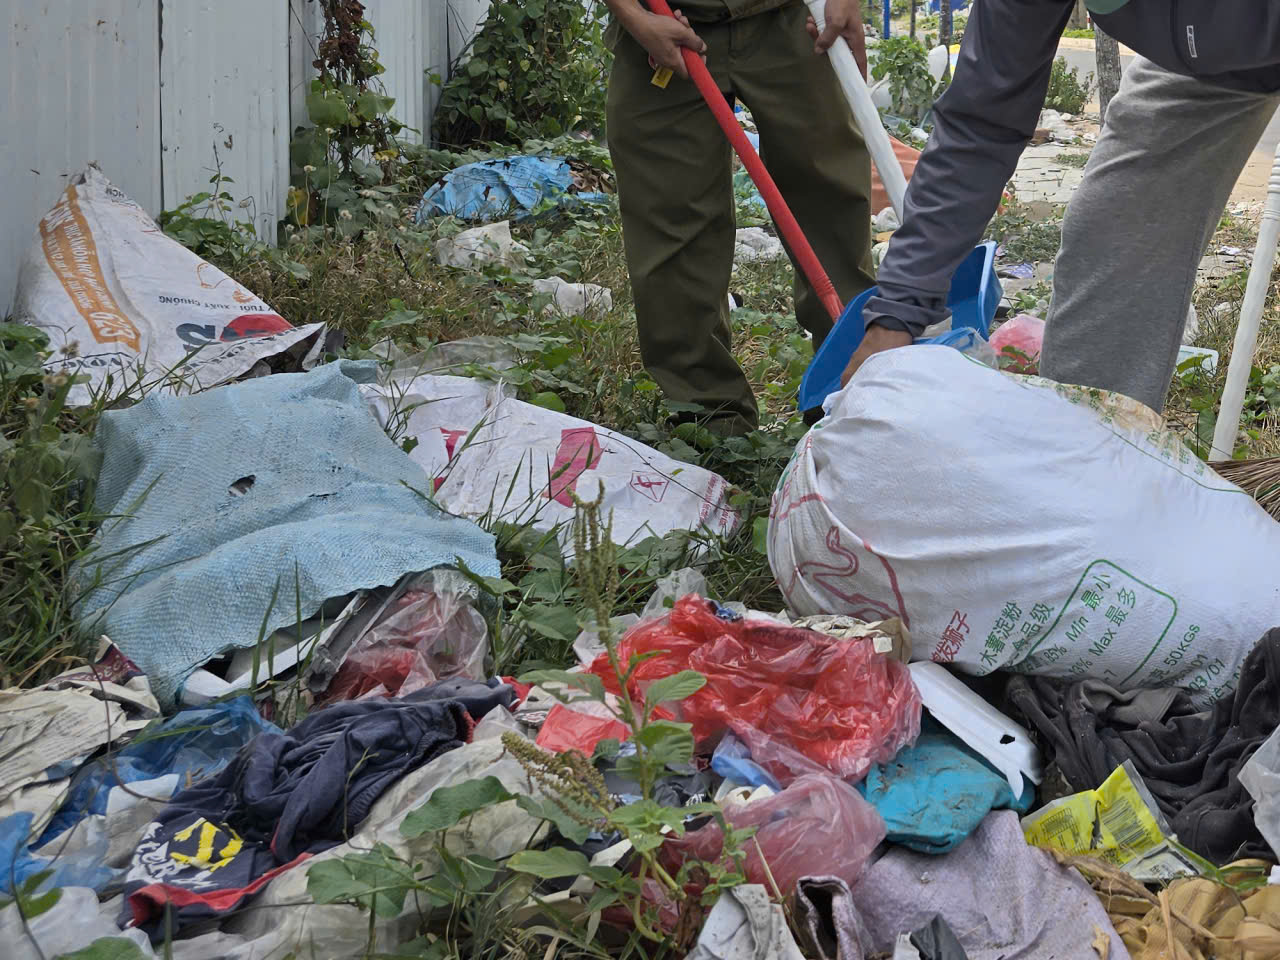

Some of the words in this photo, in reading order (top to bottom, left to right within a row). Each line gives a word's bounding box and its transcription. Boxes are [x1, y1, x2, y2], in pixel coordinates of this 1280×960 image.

[88, 312, 136, 339] 623
[1065, 616, 1089, 642] Min
[1081, 574, 1110, 611] 最小
[1088, 628, 1117, 657] Max
[1105, 586, 1136, 627] 最多
